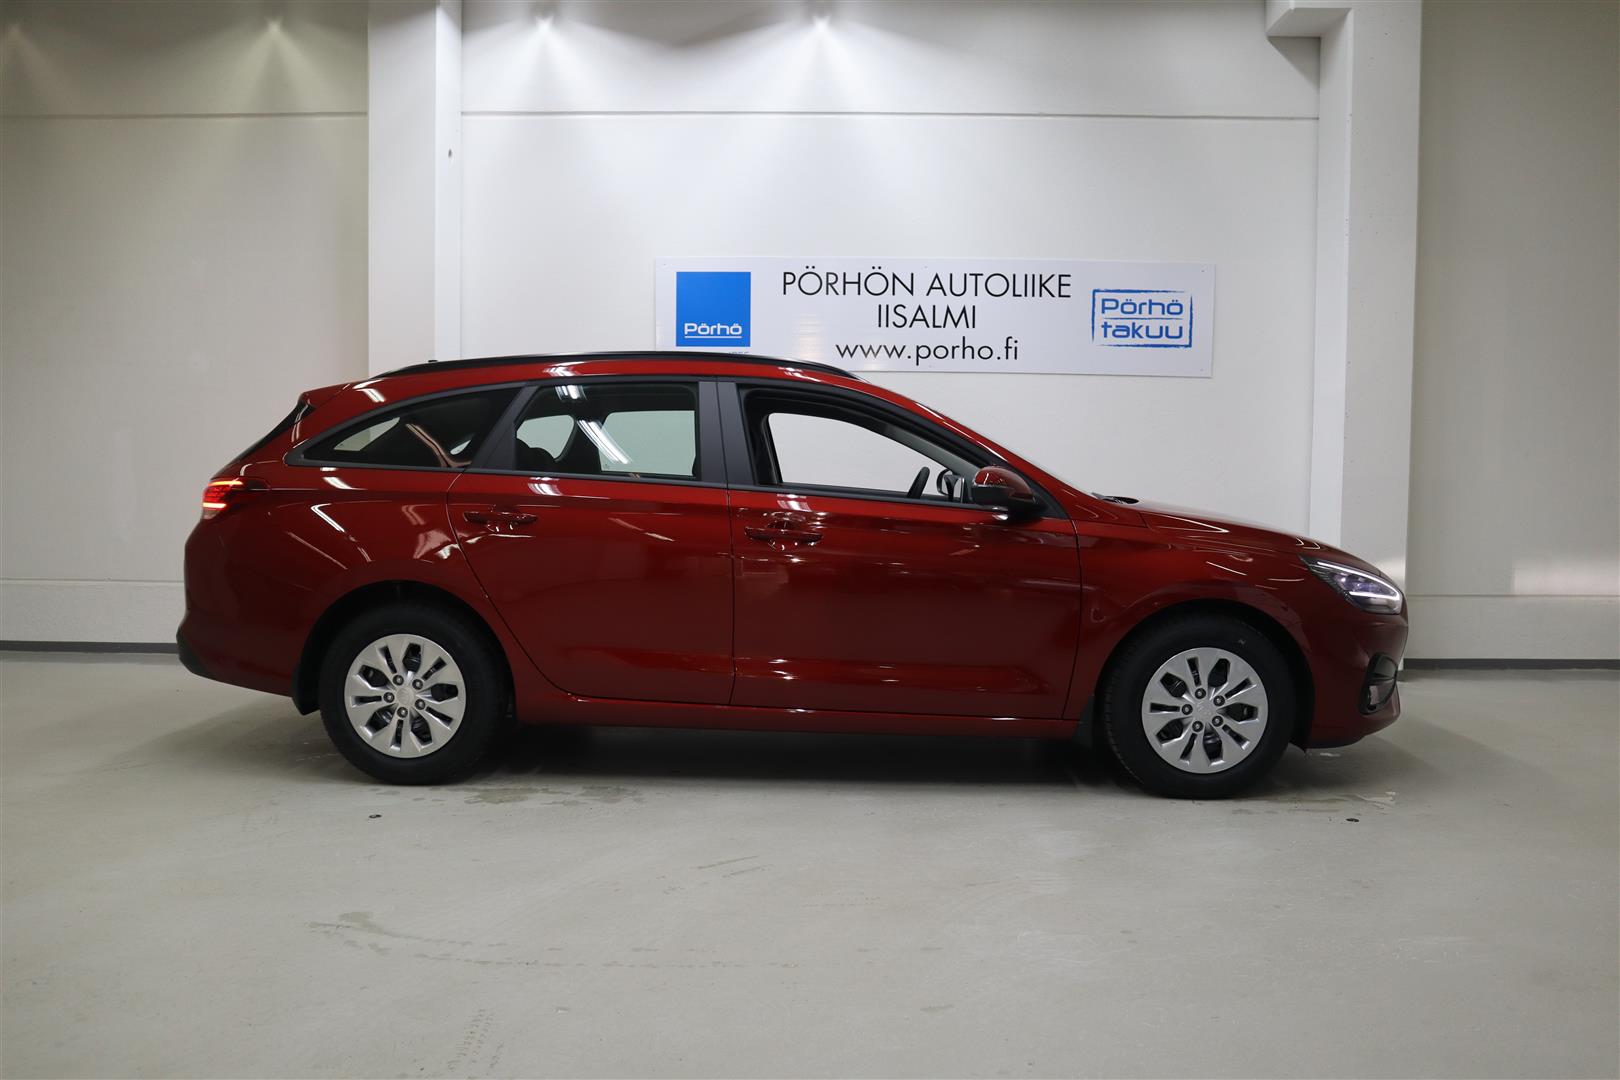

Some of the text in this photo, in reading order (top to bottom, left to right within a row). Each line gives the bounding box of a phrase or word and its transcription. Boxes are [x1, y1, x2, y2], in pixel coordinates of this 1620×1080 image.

[782, 266, 1072, 298] PÖRHÖN AUTOLIIKE
[877, 303, 976, 329] IISALMI
[1101, 298, 1184, 316] Pörhö
[684, 322, 743, 335] Pörhö
[1101, 321, 1184, 339] takuu
[835, 336, 1019, 366] www.porho.fi
